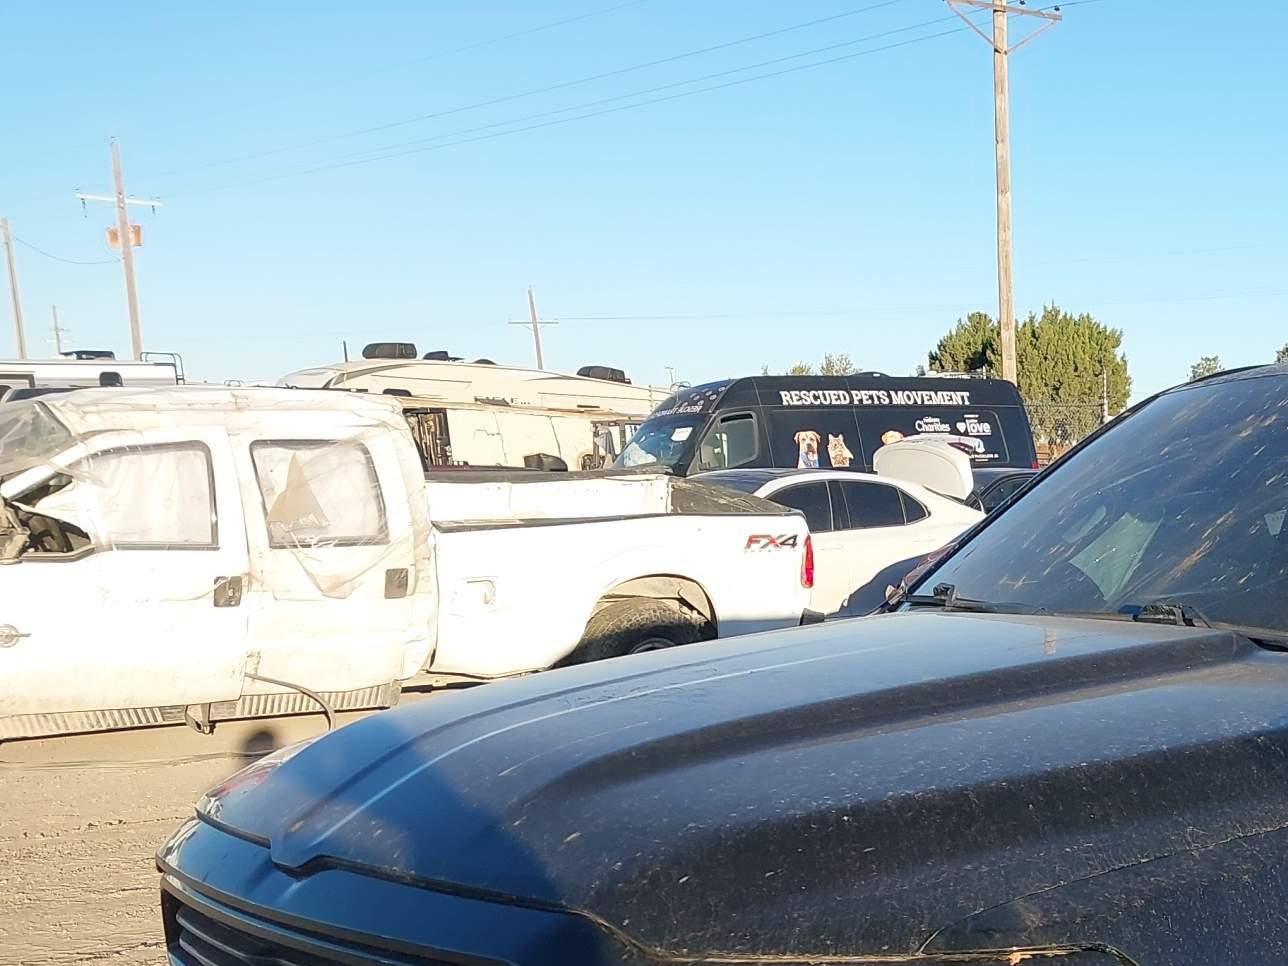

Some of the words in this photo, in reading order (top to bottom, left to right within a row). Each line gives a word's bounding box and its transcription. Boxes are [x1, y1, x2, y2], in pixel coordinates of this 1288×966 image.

[779, 390, 849, 405] RESCUED
[851, 390, 889, 405] PETS
[889, 391, 970, 405] MOVEMENT
[915, 420, 951, 432] Charities
[965, 419, 991, 433] love
[744, 534, 799, 549] FX4
